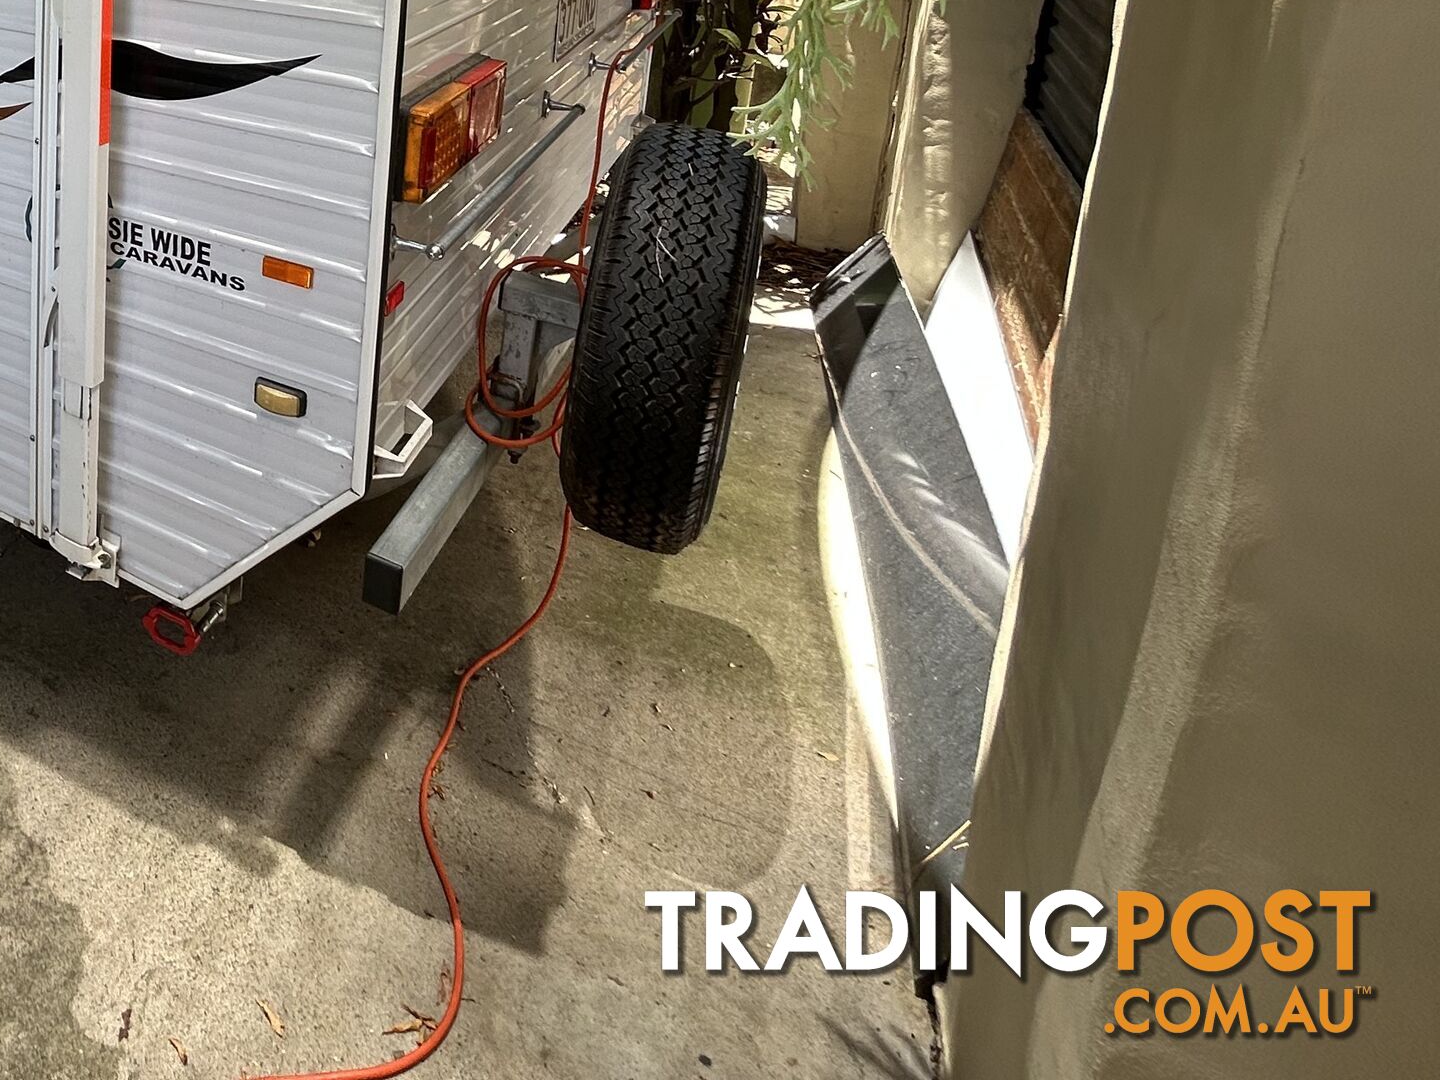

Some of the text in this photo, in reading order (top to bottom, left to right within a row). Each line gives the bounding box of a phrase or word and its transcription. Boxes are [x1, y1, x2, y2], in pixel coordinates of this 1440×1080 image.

[108, 217, 211, 266] SIE WIDE
[110, 241, 246, 291] CARAVANS
